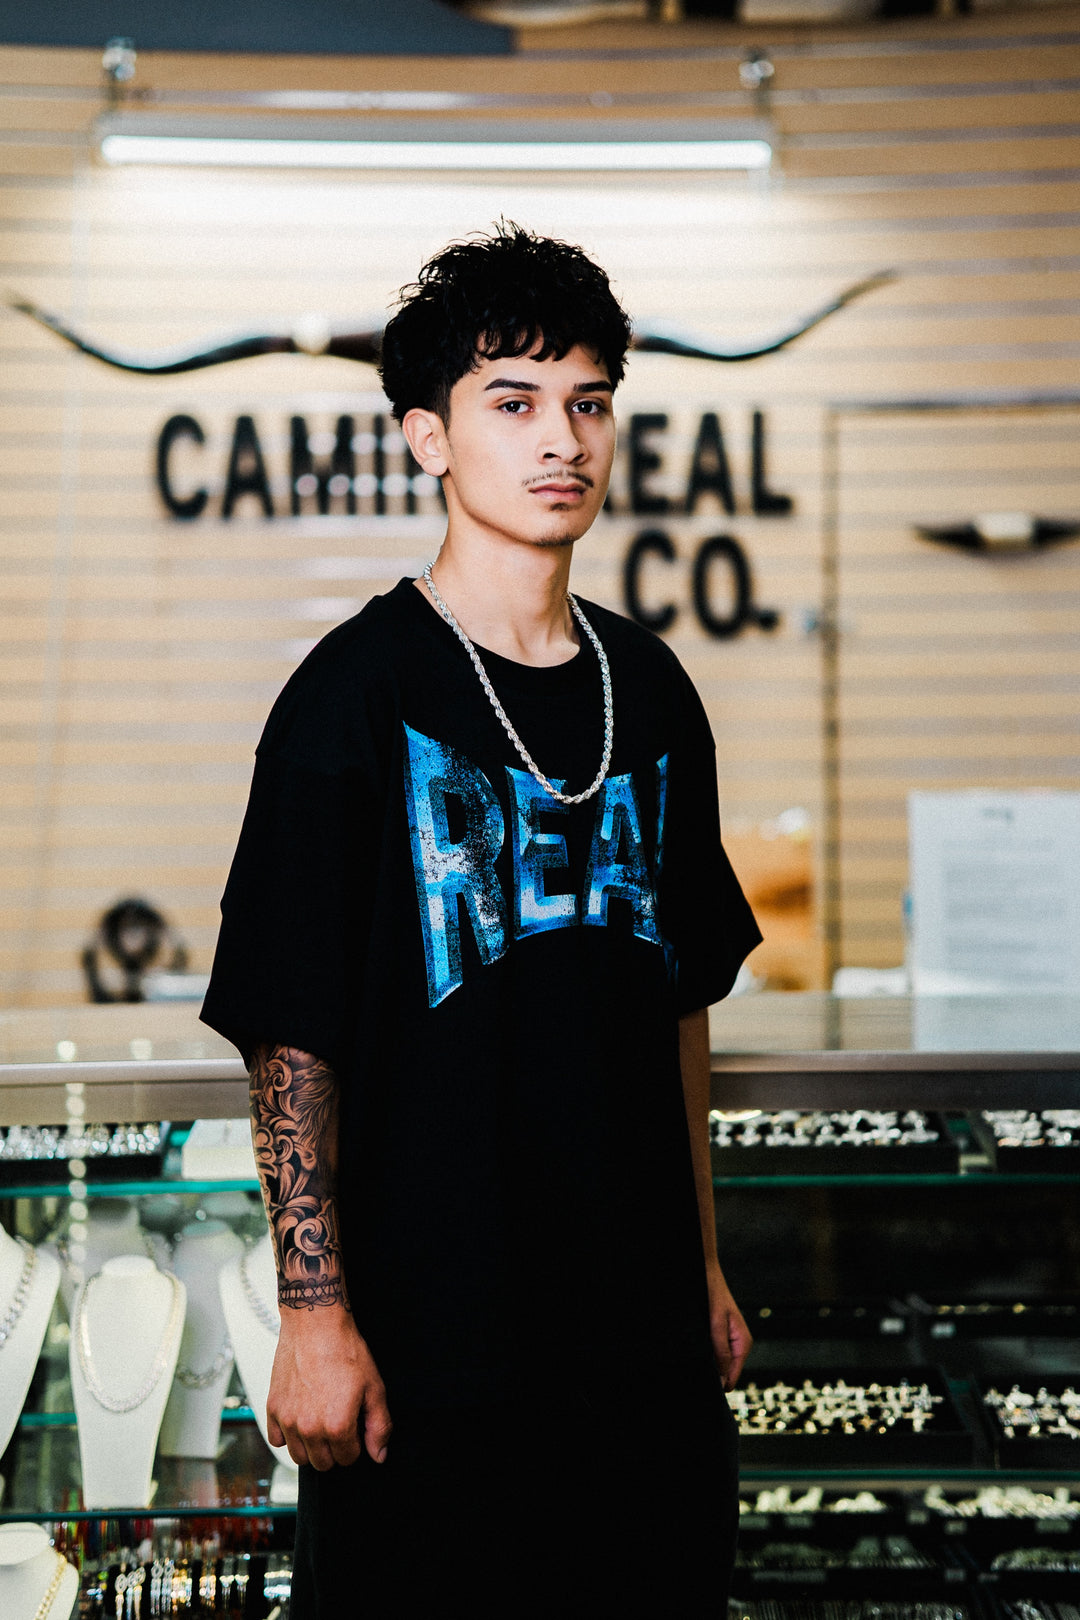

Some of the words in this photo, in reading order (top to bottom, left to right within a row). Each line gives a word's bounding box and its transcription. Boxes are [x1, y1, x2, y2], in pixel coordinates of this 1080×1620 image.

[157, 414, 448, 520] CAMI
[603, 412, 792, 517] EAL
[624, 530, 779, 640] CO.
